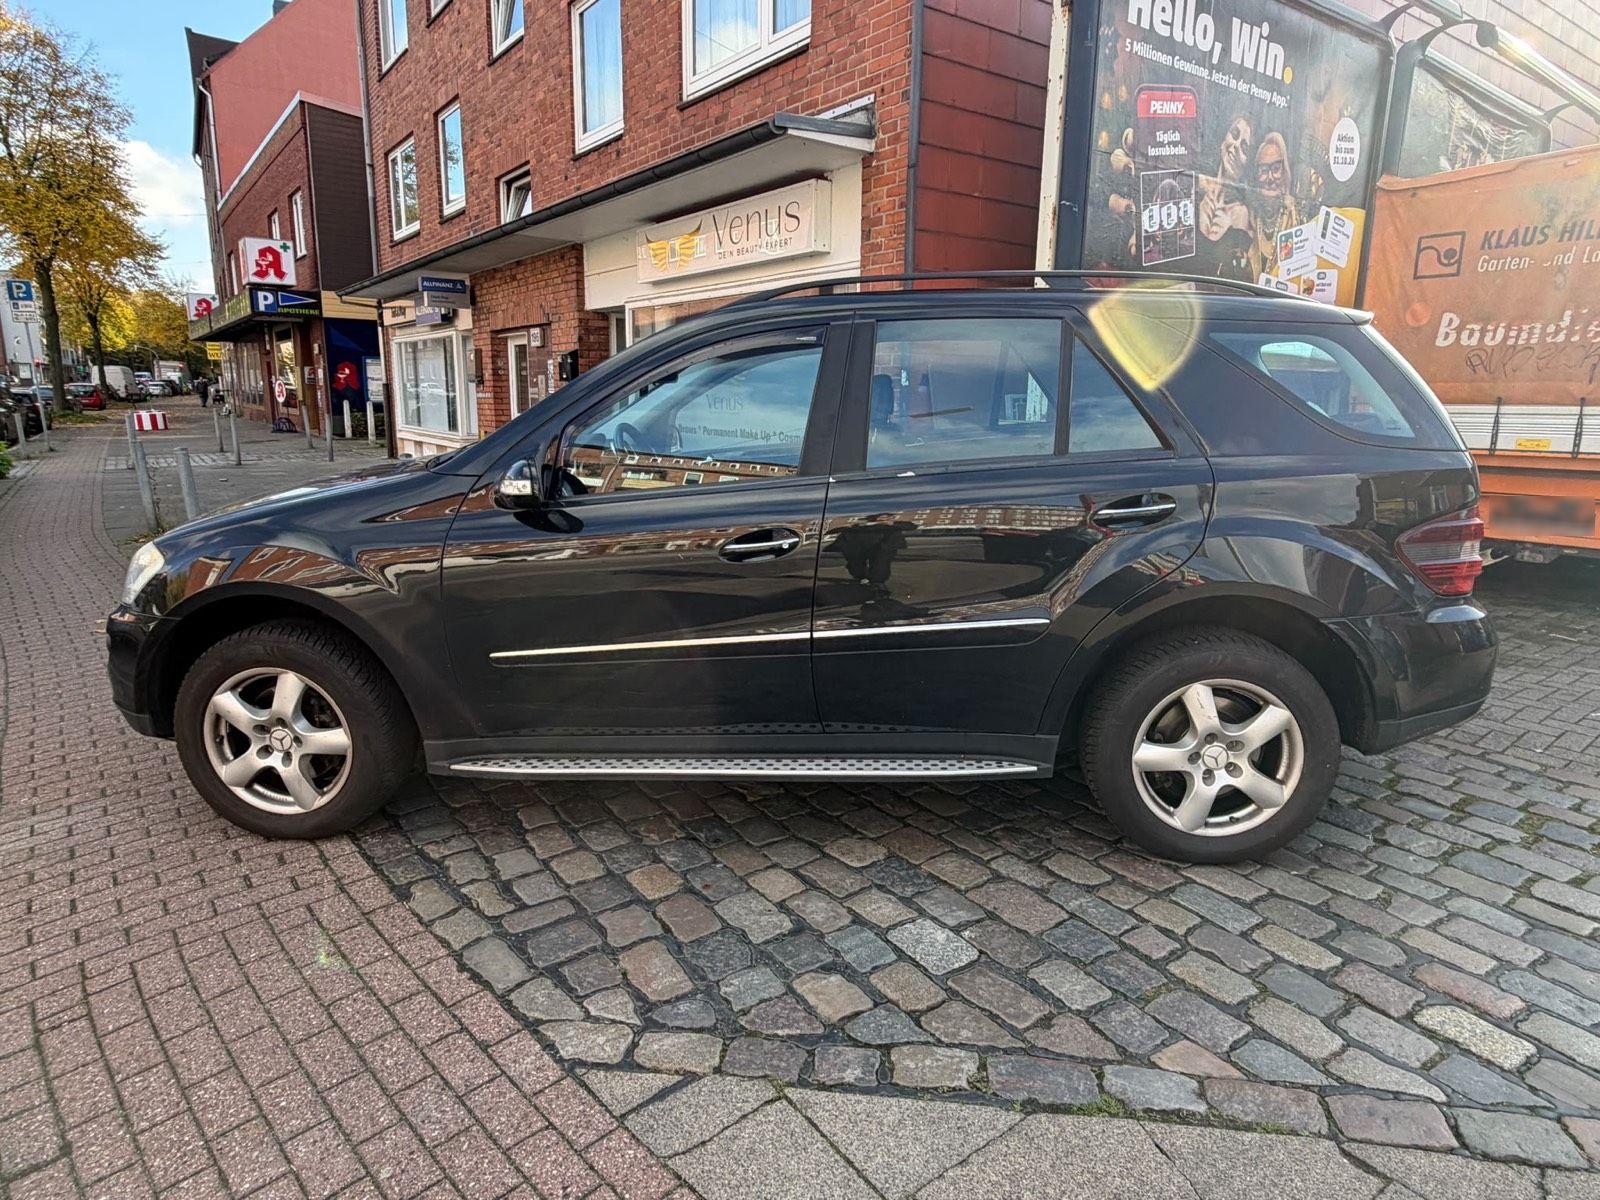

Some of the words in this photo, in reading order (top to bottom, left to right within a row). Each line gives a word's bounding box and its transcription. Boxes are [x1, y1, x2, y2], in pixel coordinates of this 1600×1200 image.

[1127, 0, 1222, 65] Hello,
[1231, 17, 1293, 85] Win.
[1125, 38, 1132, 52] 5
[1132, 40, 1173, 67] Millionen
[1173, 55, 1211, 80] Gewinne.
[1211, 69, 1229, 87] Jetzt
[1229, 74, 1237, 90] in
[1237, 79, 1250, 94] der
[1250, 83, 1272, 104] Penny
[1156, 130, 1181, 144] Täglich
[1337, 133, 1354, 143] Aktion
[1148, 144, 1188, 157] losrubbeln.
[1335, 144, 1343, 154] bis
[713, 201, 801, 248] Venus
[1479, 225, 1551, 251] KLAUS
[718, 251, 734, 260] DEIN
[736, 244, 763, 257] BEAUTY
[765, 237, 793, 250] EXPERT
[1478, 255, 1535, 273] Garten-
[12, 282, 27, 299] P
[257, 291, 275, 312] P
[278, 307, 320, 315] APOTHEKE
[705, 394, 744, 411] Venus
[702, 426, 738, 438] Permanent
[740, 428, 759, 440] Make
[761, 430, 771, 442] Up
